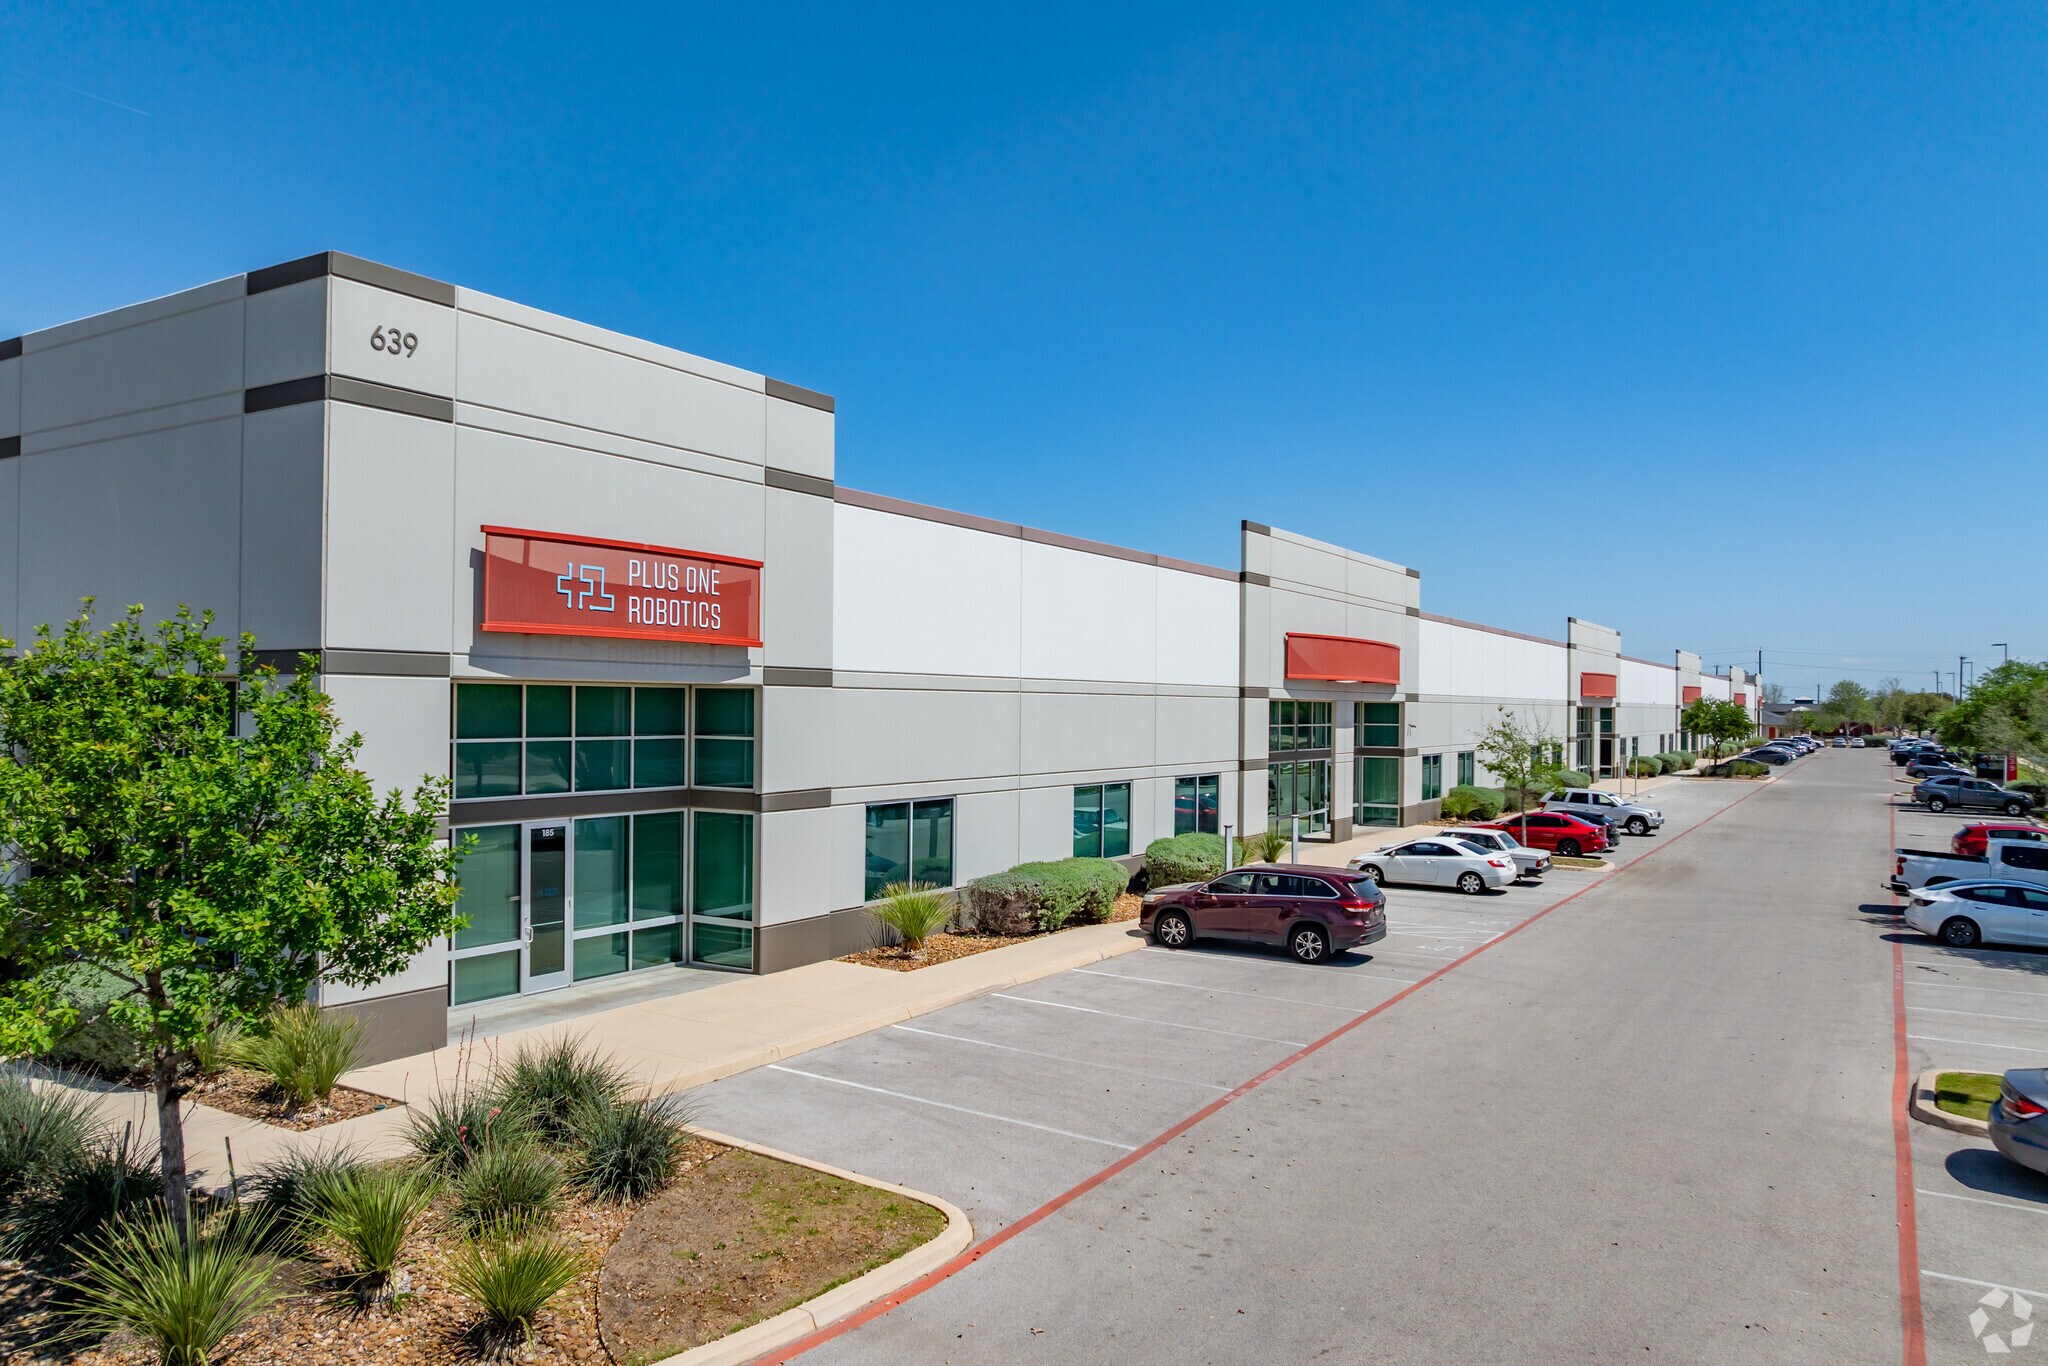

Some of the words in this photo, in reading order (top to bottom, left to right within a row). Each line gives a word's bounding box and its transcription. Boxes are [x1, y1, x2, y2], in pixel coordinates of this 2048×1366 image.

[370, 325, 419, 358] 639
[628, 559, 679, 591] PLUS
[686, 566, 721, 595] ONE
[628, 595, 721, 630] ROBOTICS
[542, 828, 555, 837] 185
